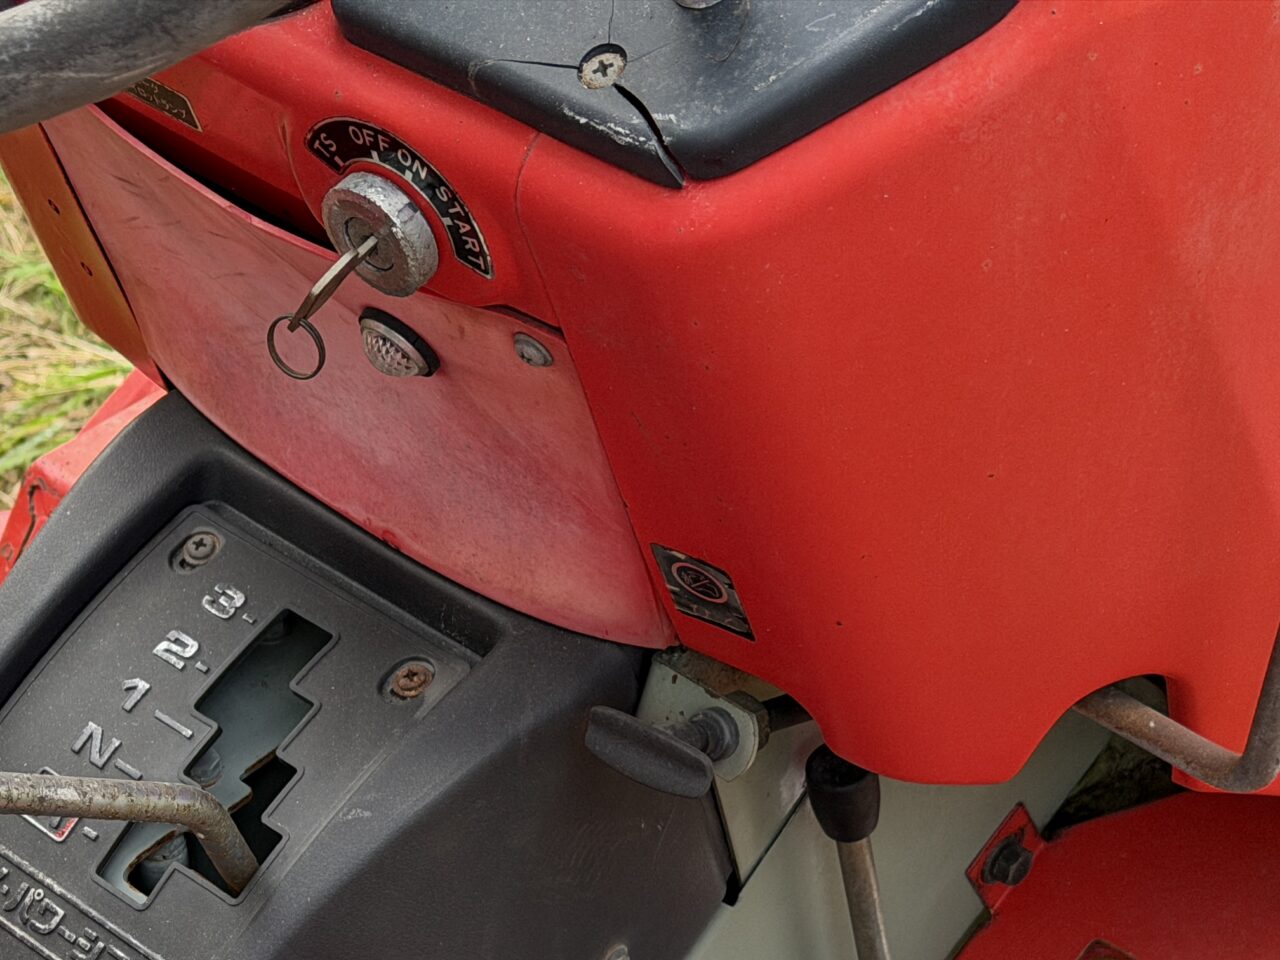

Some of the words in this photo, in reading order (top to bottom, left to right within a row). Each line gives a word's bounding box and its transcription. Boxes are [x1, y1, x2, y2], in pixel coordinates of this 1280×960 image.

[349, 126, 391, 152] OFF
[398, 149, 428, 181] ON
[436, 186, 485, 270] START
[202, 583, 245, 619] 3
[152, 629, 199, 670] 2
[122, 677, 151, 712] 1
[71, 720, 122, 769] N
